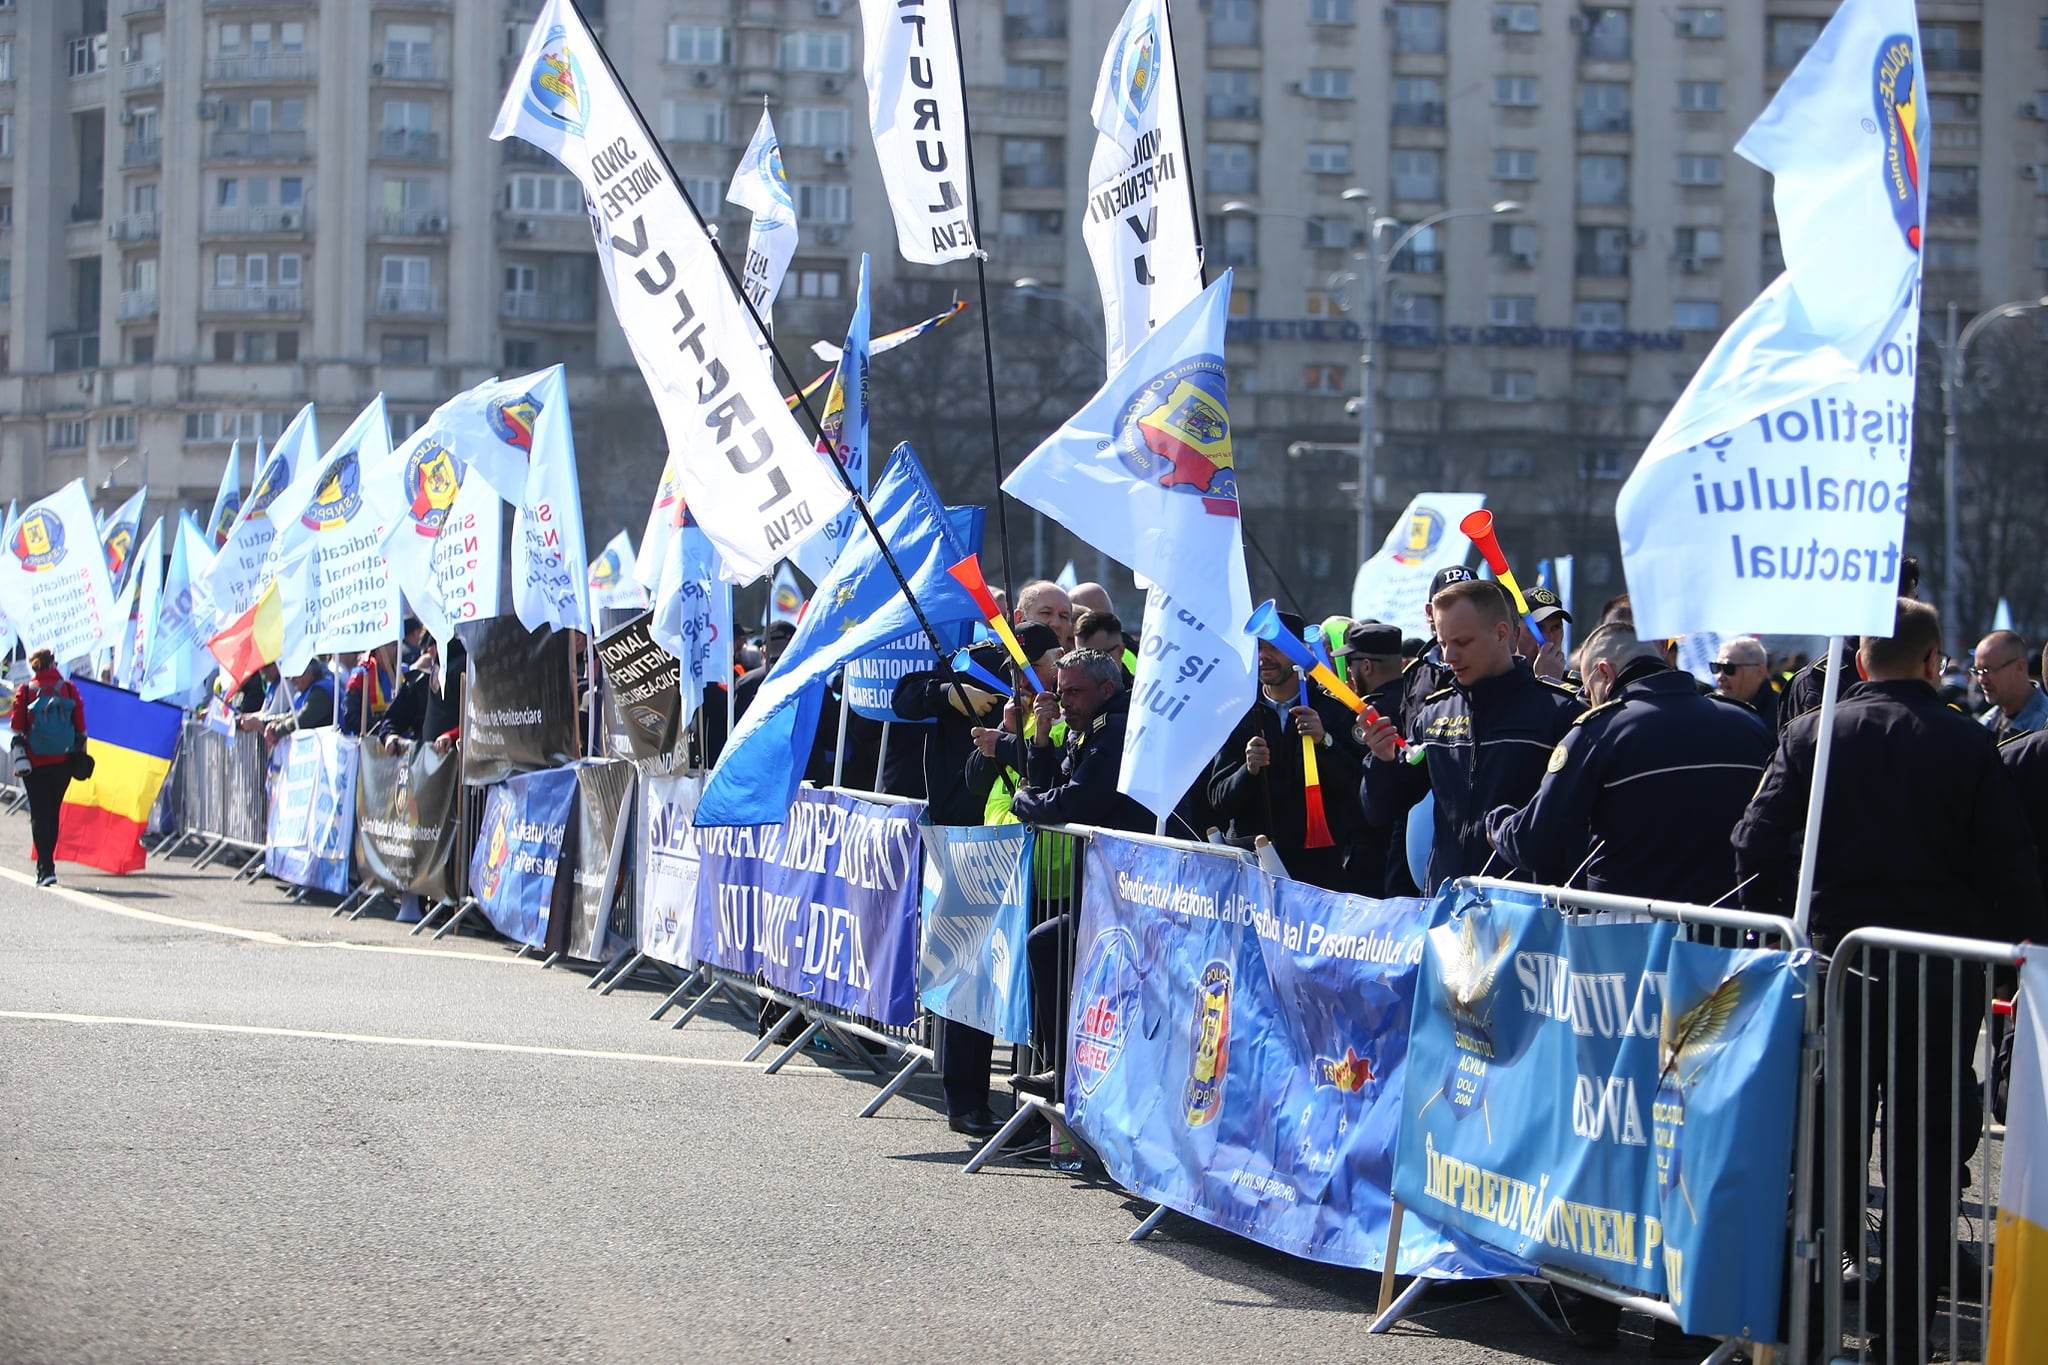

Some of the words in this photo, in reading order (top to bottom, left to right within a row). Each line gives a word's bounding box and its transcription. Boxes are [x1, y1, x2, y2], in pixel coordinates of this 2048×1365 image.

[1444, 569, 1473, 584] IPA
[1175, 655, 1221, 684] și
[1118, 870, 1171, 910] Sindicatul
[1222, 893, 1235, 923] al
[1458, 1054, 1487, 1078] ACVILA
[1456, 1077, 1478, 1095] DOLJ
[1454, 1091, 1474, 1108] 2004
